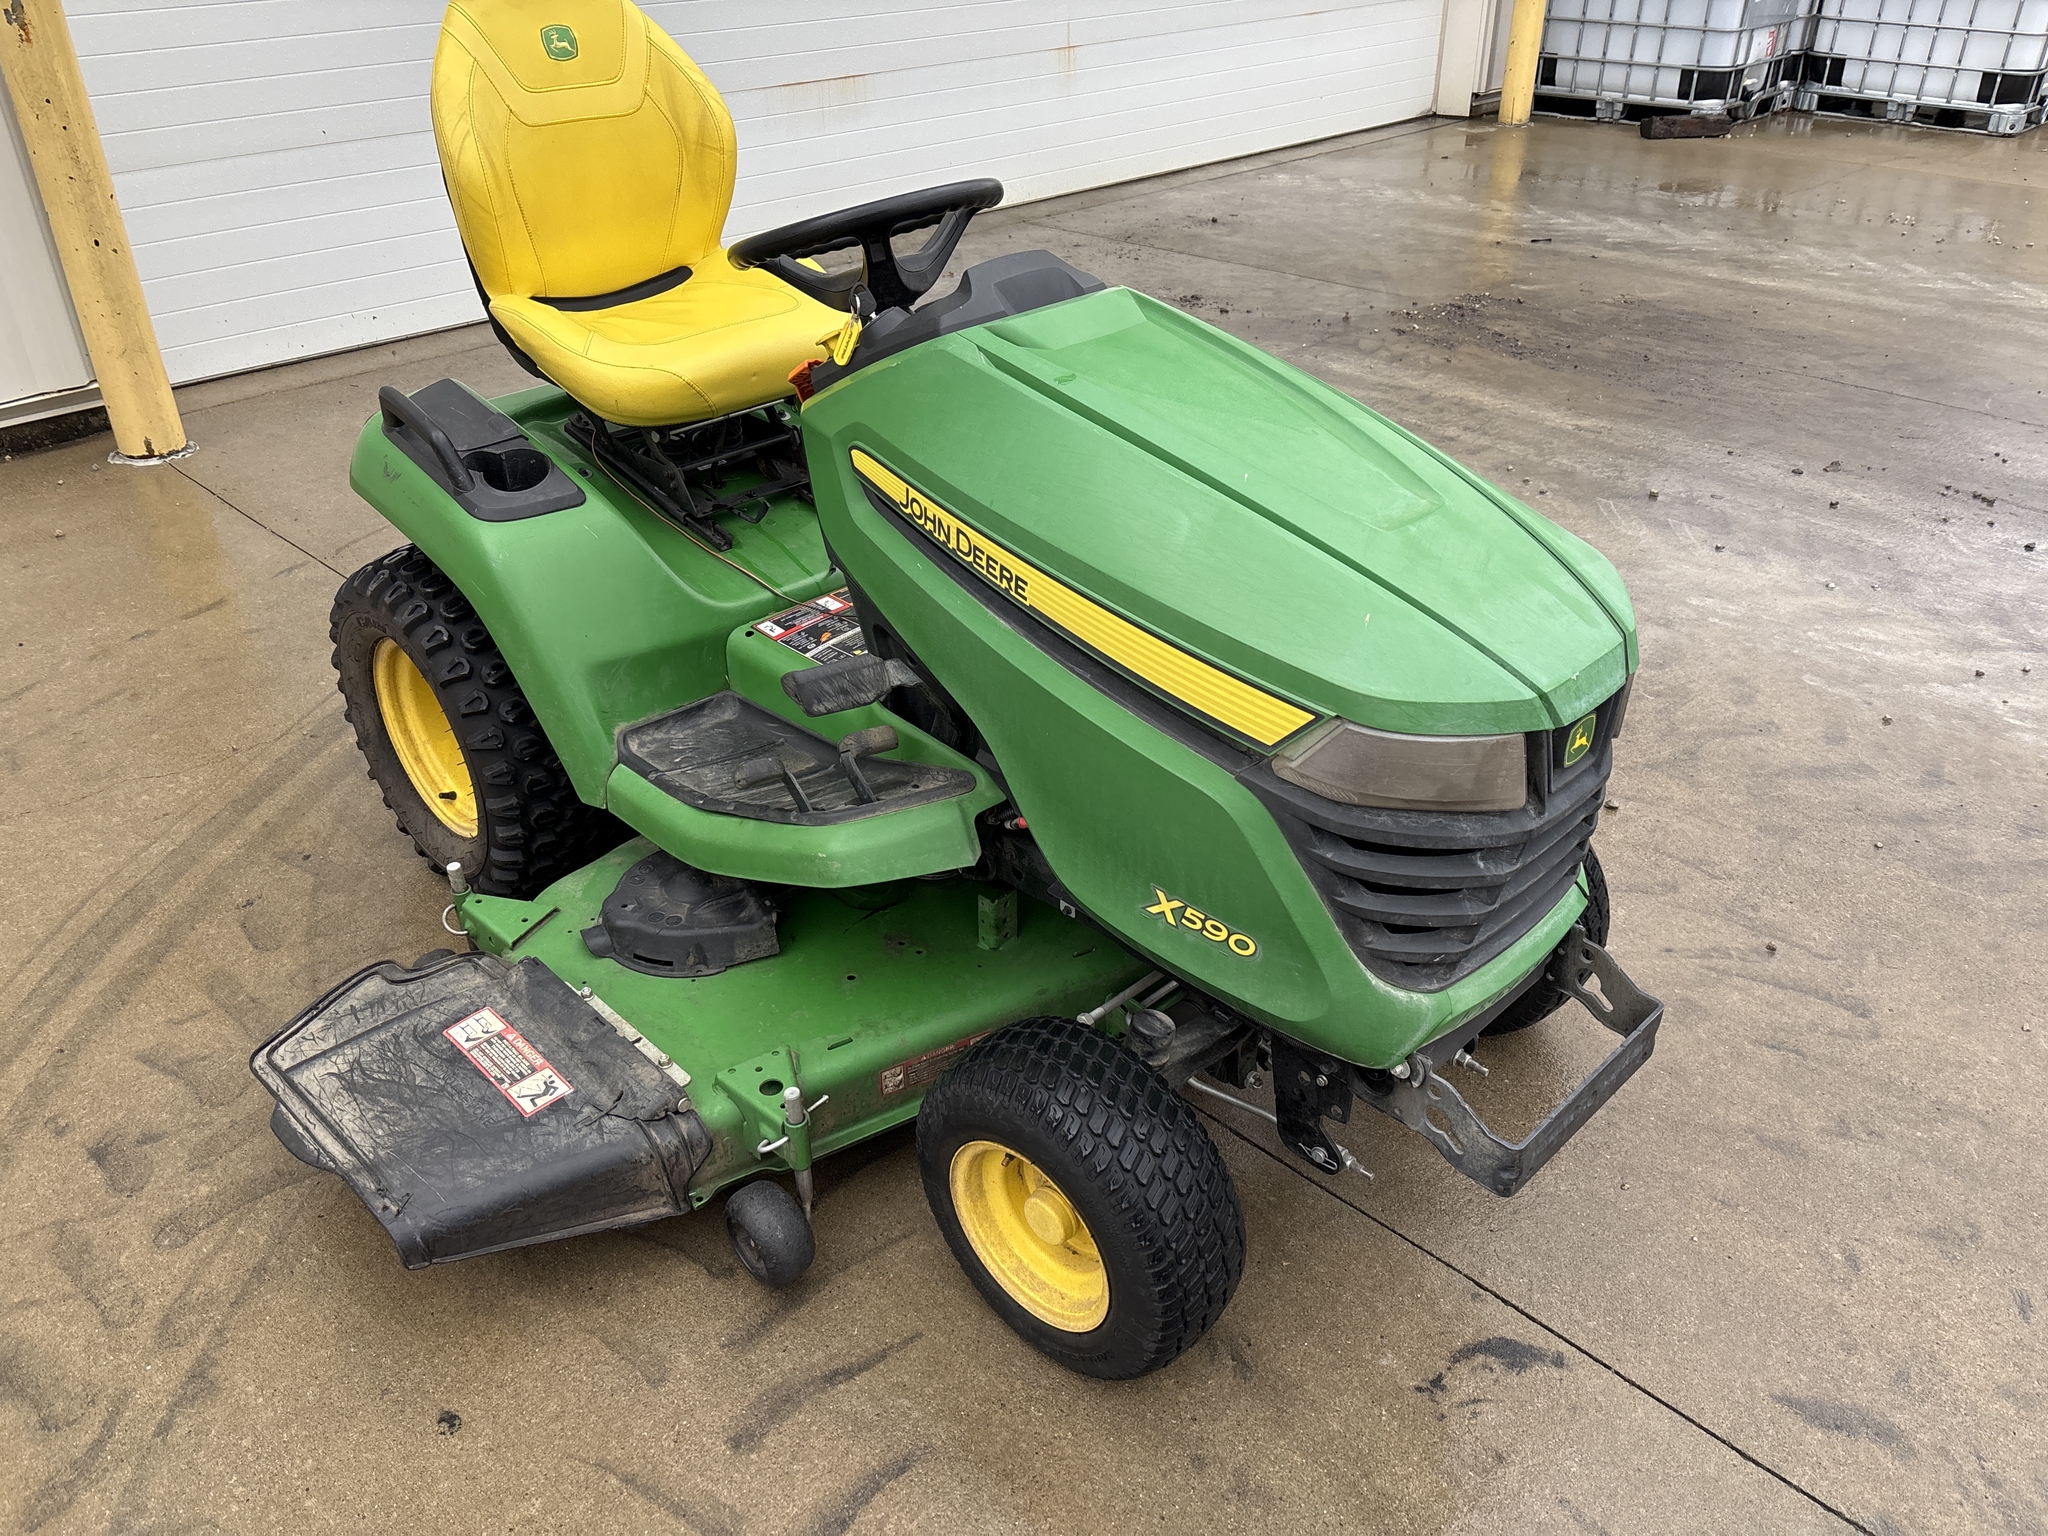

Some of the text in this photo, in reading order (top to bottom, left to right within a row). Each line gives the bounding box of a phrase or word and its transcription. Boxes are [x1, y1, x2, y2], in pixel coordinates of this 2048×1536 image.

[899, 487, 1029, 602] JOHN DEERE
[1142, 886, 1257, 957] X590
[513, 1038, 544, 1066] DANGER
